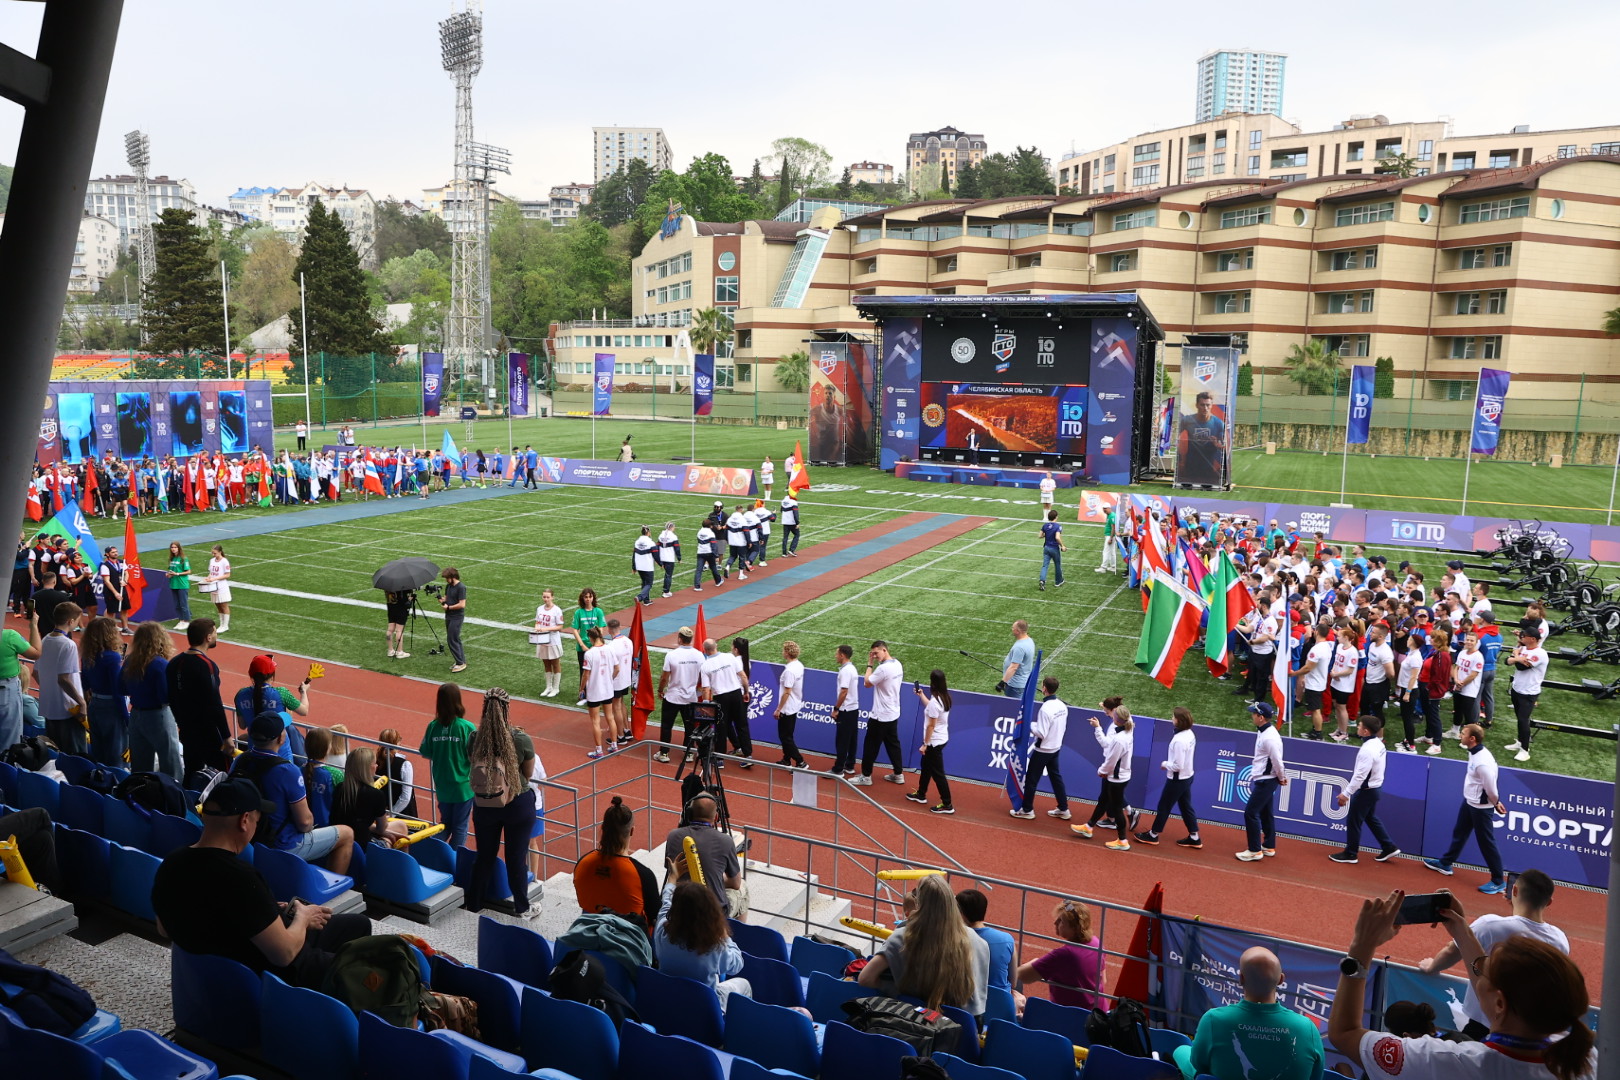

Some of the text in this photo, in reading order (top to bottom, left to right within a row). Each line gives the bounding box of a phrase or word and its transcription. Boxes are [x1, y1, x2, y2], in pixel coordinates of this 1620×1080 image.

[957, 345, 969, 355] 50
[995, 340, 1014, 351] ГТО
[968, 386, 1013, 394] ЧЕЛЯБИНСКАЯ
[1062, 404, 1083, 420] 10
[573, 469, 612, 477] СПОРТЛОТО
[1300, 512, 1326, 520] СПОРТ
[1300, 519, 1330, 527] НОРМА
[1300, 526, 1330, 534] ЖИЗНИ
[1217, 749, 1236, 758] 2014
[1508, 793, 1606, 817] ГЕНЕРАЛЬНЫЙ
[1329, 822, 1348, 832] 2024
[1238, 1023, 1290, 1034] САХАЛИНСКАЯ
[1248, 1033, 1281, 1042] ОБЛАСТЬ
